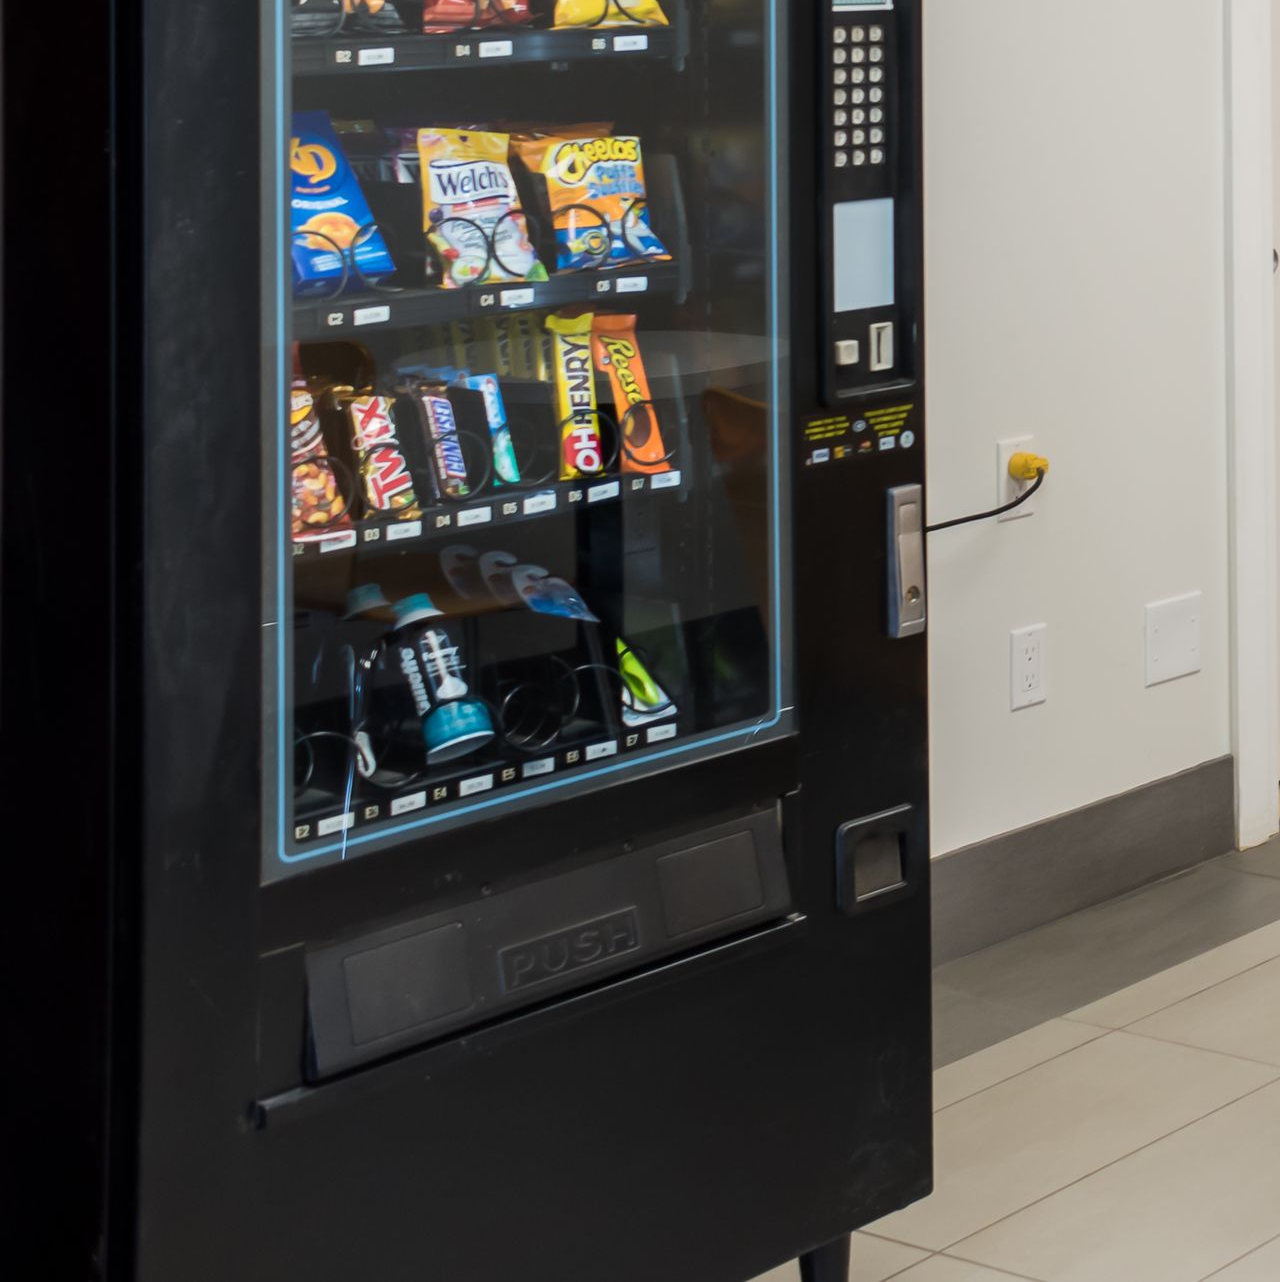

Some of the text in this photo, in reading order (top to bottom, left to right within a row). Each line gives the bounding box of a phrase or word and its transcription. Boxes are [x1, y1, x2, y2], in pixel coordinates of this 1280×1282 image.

[336, 50, 352, 63] B2
[456, 44, 471, 57] B4
[556, 138, 638, 185] Cheetos
[434, 165, 509, 197] Welch's
[480, 294, 495, 307] C4
[328, 312, 344, 326] C2
[573, 427, 600, 473] OH
[626, 733, 639, 747] E7
[433, 786, 447, 800] E4
[295, 824, 310, 839] E2
[511, 916, 637, 986] PUSH
